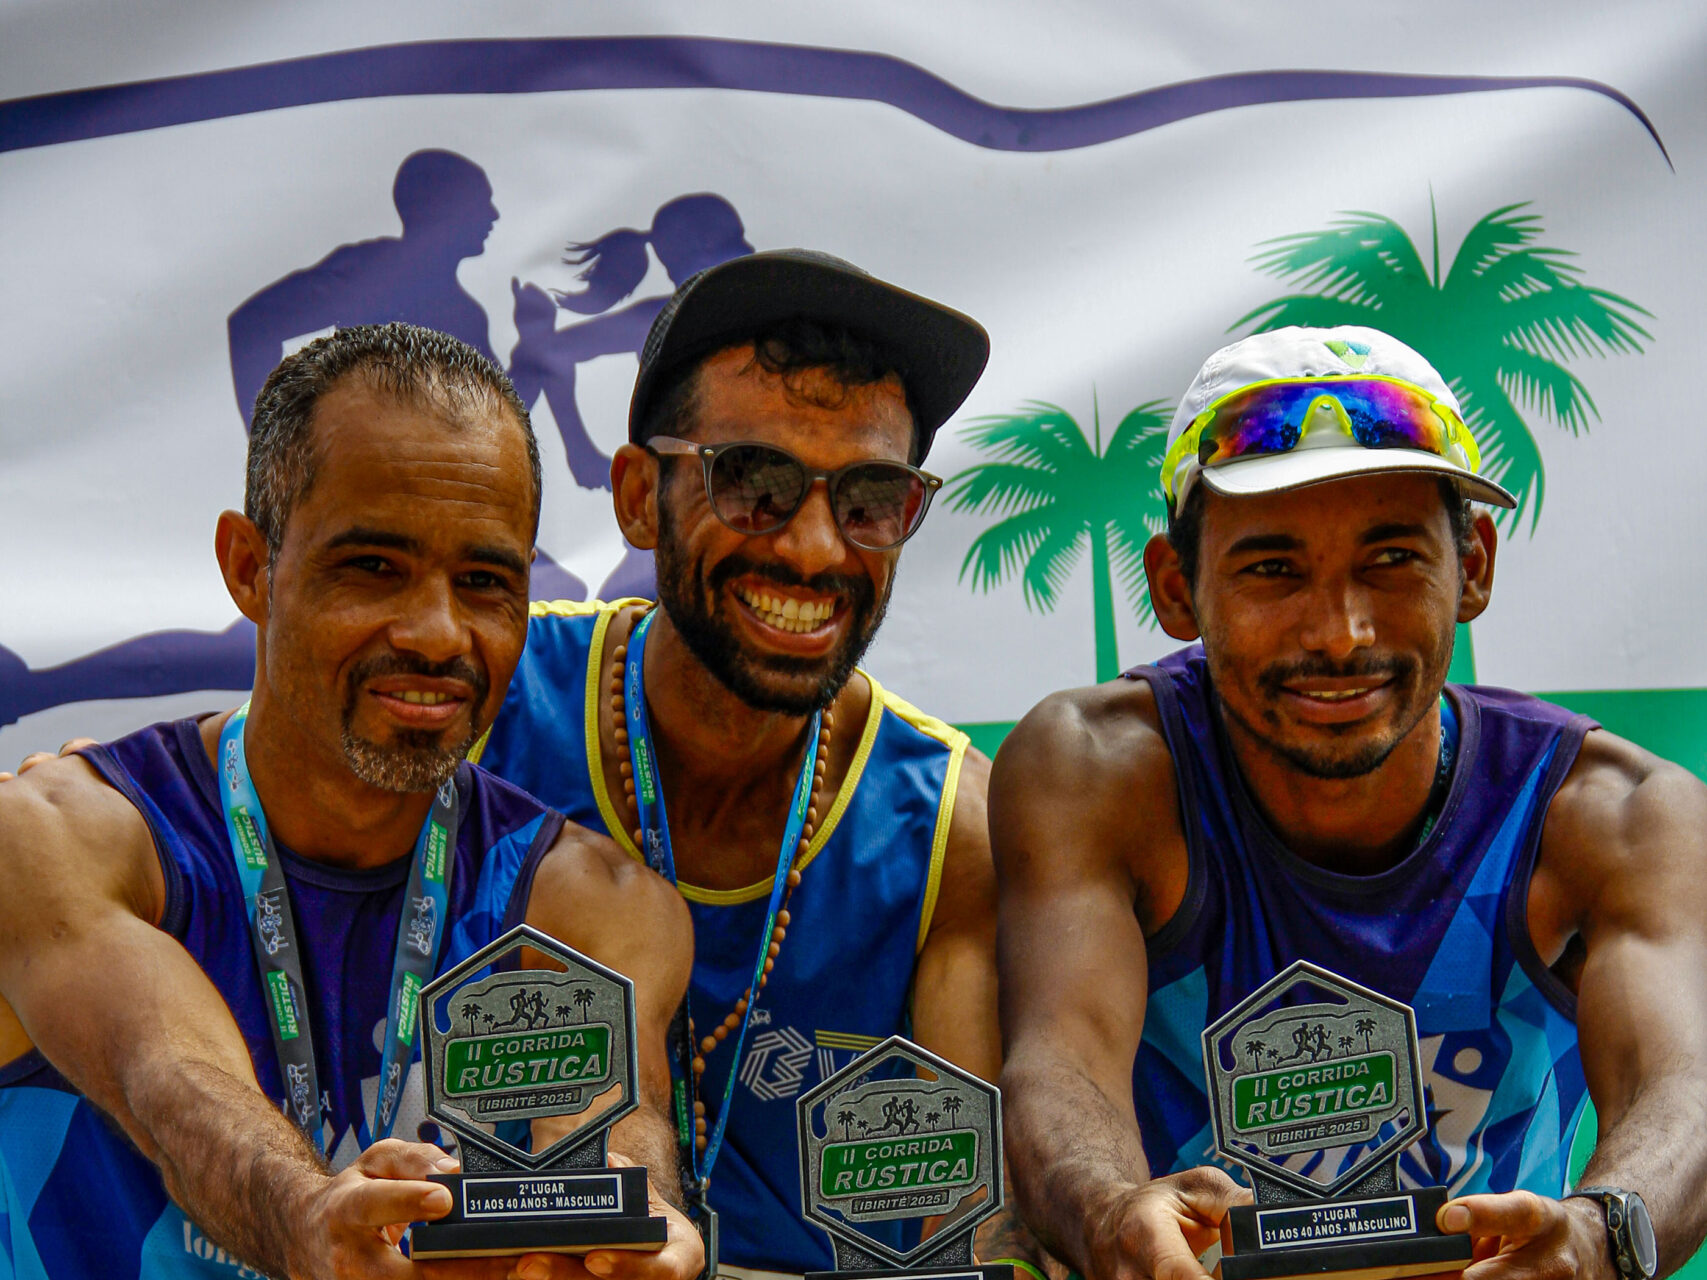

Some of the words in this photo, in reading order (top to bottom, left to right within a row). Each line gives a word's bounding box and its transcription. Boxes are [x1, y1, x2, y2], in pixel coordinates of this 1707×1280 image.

[468, 1043, 481, 1061] II
[492, 1032, 585, 1056] CORRIDA
[459, 1053, 601, 1089] RÚSTICA
[1254, 1079, 1267, 1097] II
[1278, 1061, 1370, 1090] CORRIDA
[540, 1092, 572, 1105] 2025
[1247, 1082, 1387, 1125] RÚSTICA
[1328, 1120, 1361, 1136] 2025
[843, 1149, 855, 1165] II
[865, 1138, 953, 1160] CORRIDA
[834, 1158, 968, 1190] RÚSTICA
[531, 1183, 565, 1195] LUGAR
[910, 1195, 941, 1206] 2025
[470, 1200, 481, 1211] 31
[484, 1199, 504, 1210] AOS
[507, 1198, 518, 1209] 40
[520, 1197, 548, 1209] ANOS
[555, 1195, 615, 1208] MASCULINO
[1324, 1208, 1358, 1222] LUGAR
[1265, 1230, 1276, 1242] 31
[1279, 1226, 1299, 1240] AOS
[1300, 1225, 1312, 1237] 40
[1314, 1222, 1342, 1236] ANOS
[1349, 1216, 1407, 1233] MASCULINO
